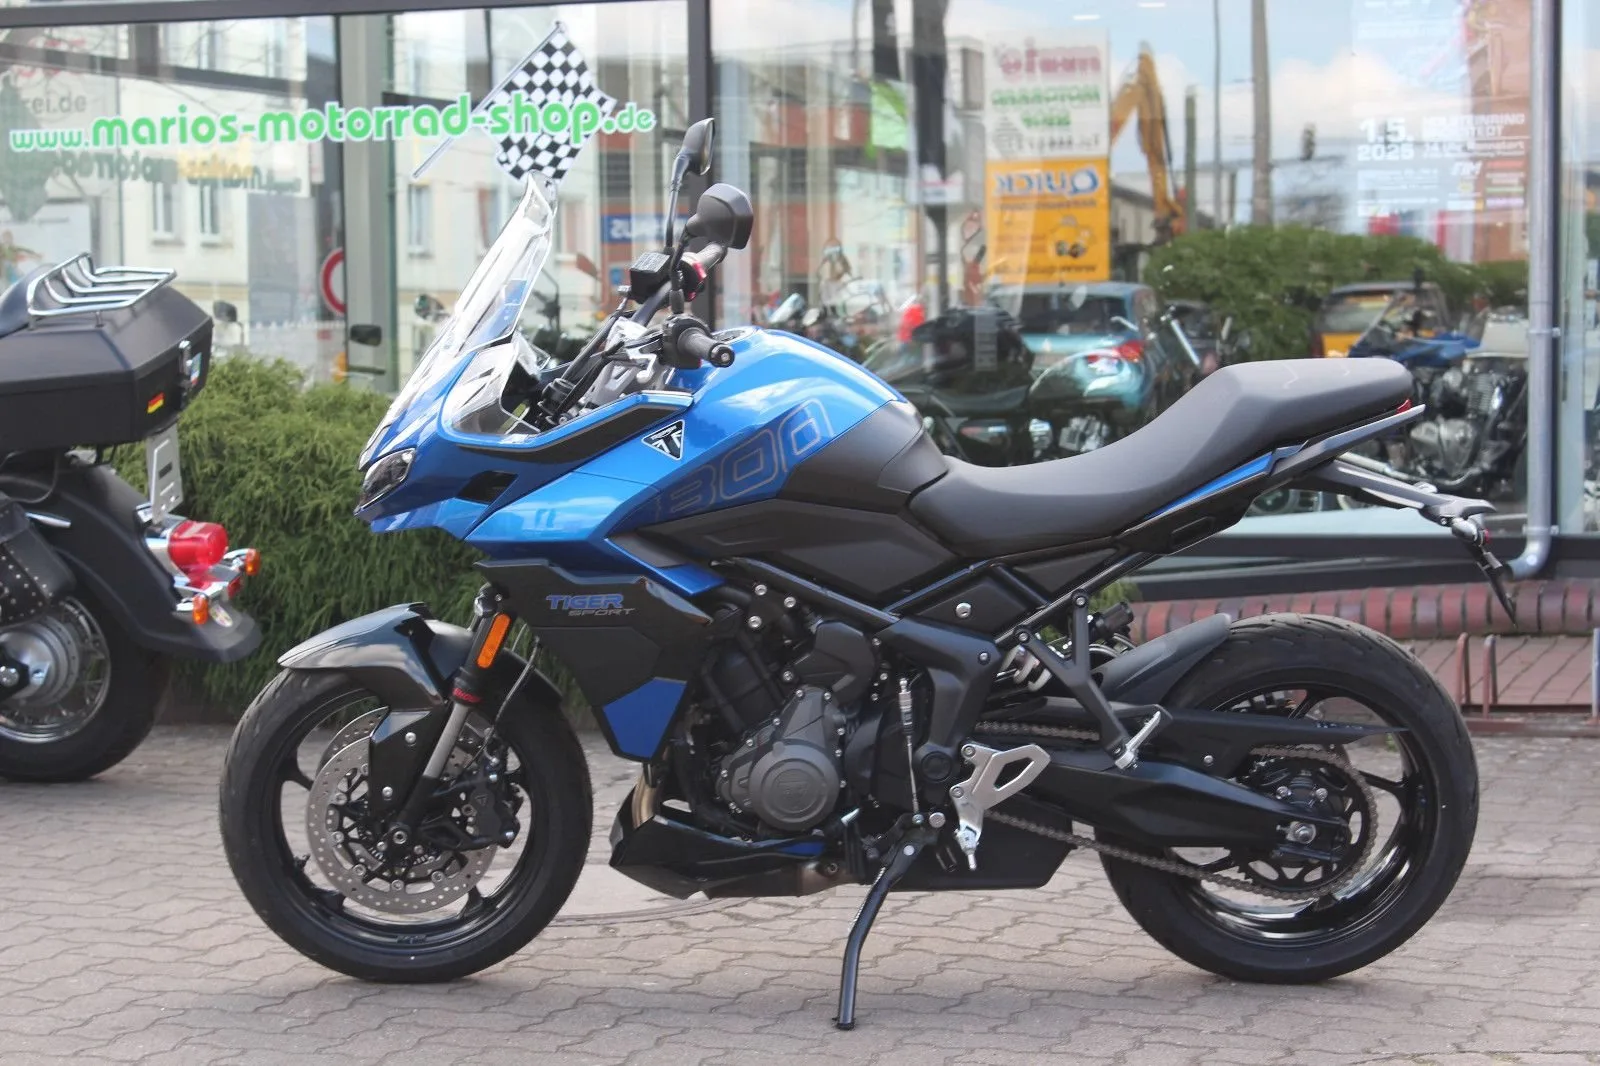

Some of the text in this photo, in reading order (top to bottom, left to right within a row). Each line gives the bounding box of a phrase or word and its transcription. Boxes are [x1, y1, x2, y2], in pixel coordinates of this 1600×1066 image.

[10, 93, 655, 150] www.marios-motorrad-shop.de
[1357, 143, 1414, 161] 2025
[545, 594, 624, 610] TIGER
[568, 607, 636, 617] SPORT
